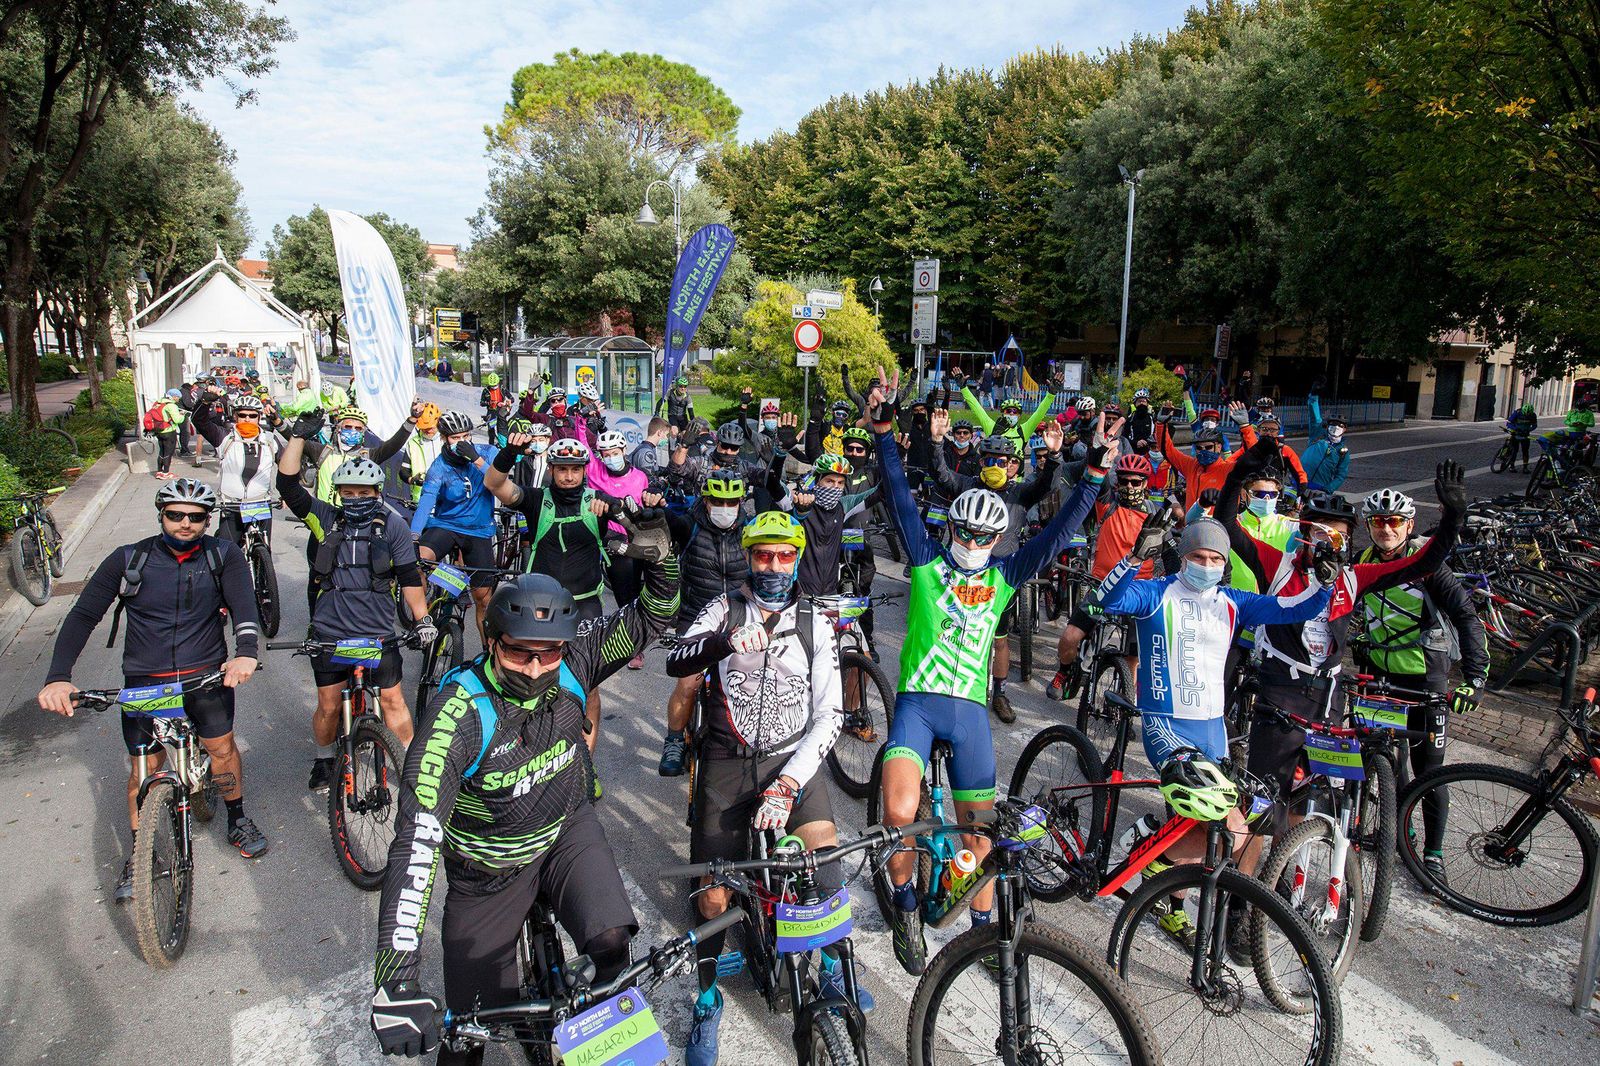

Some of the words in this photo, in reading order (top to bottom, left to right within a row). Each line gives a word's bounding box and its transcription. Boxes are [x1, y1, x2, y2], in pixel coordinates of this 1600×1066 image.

[672, 267, 699, 317] NORTH
[697, 231, 719, 269] EAST
[683, 293, 703, 325] BIKE
[698, 241, 731, 296] FESTIVAL
[482, 739, 567, 791] SGANCIO
[1309, 750, 1349, 764] NICOLETTI
[392, 812, 443, 951] RAPIDO
[1472, 908, 1515, 923] BARZO
[576, 1020, 638, 1066] MASARIN
[579, 1013, 598, 1027] NORTH
